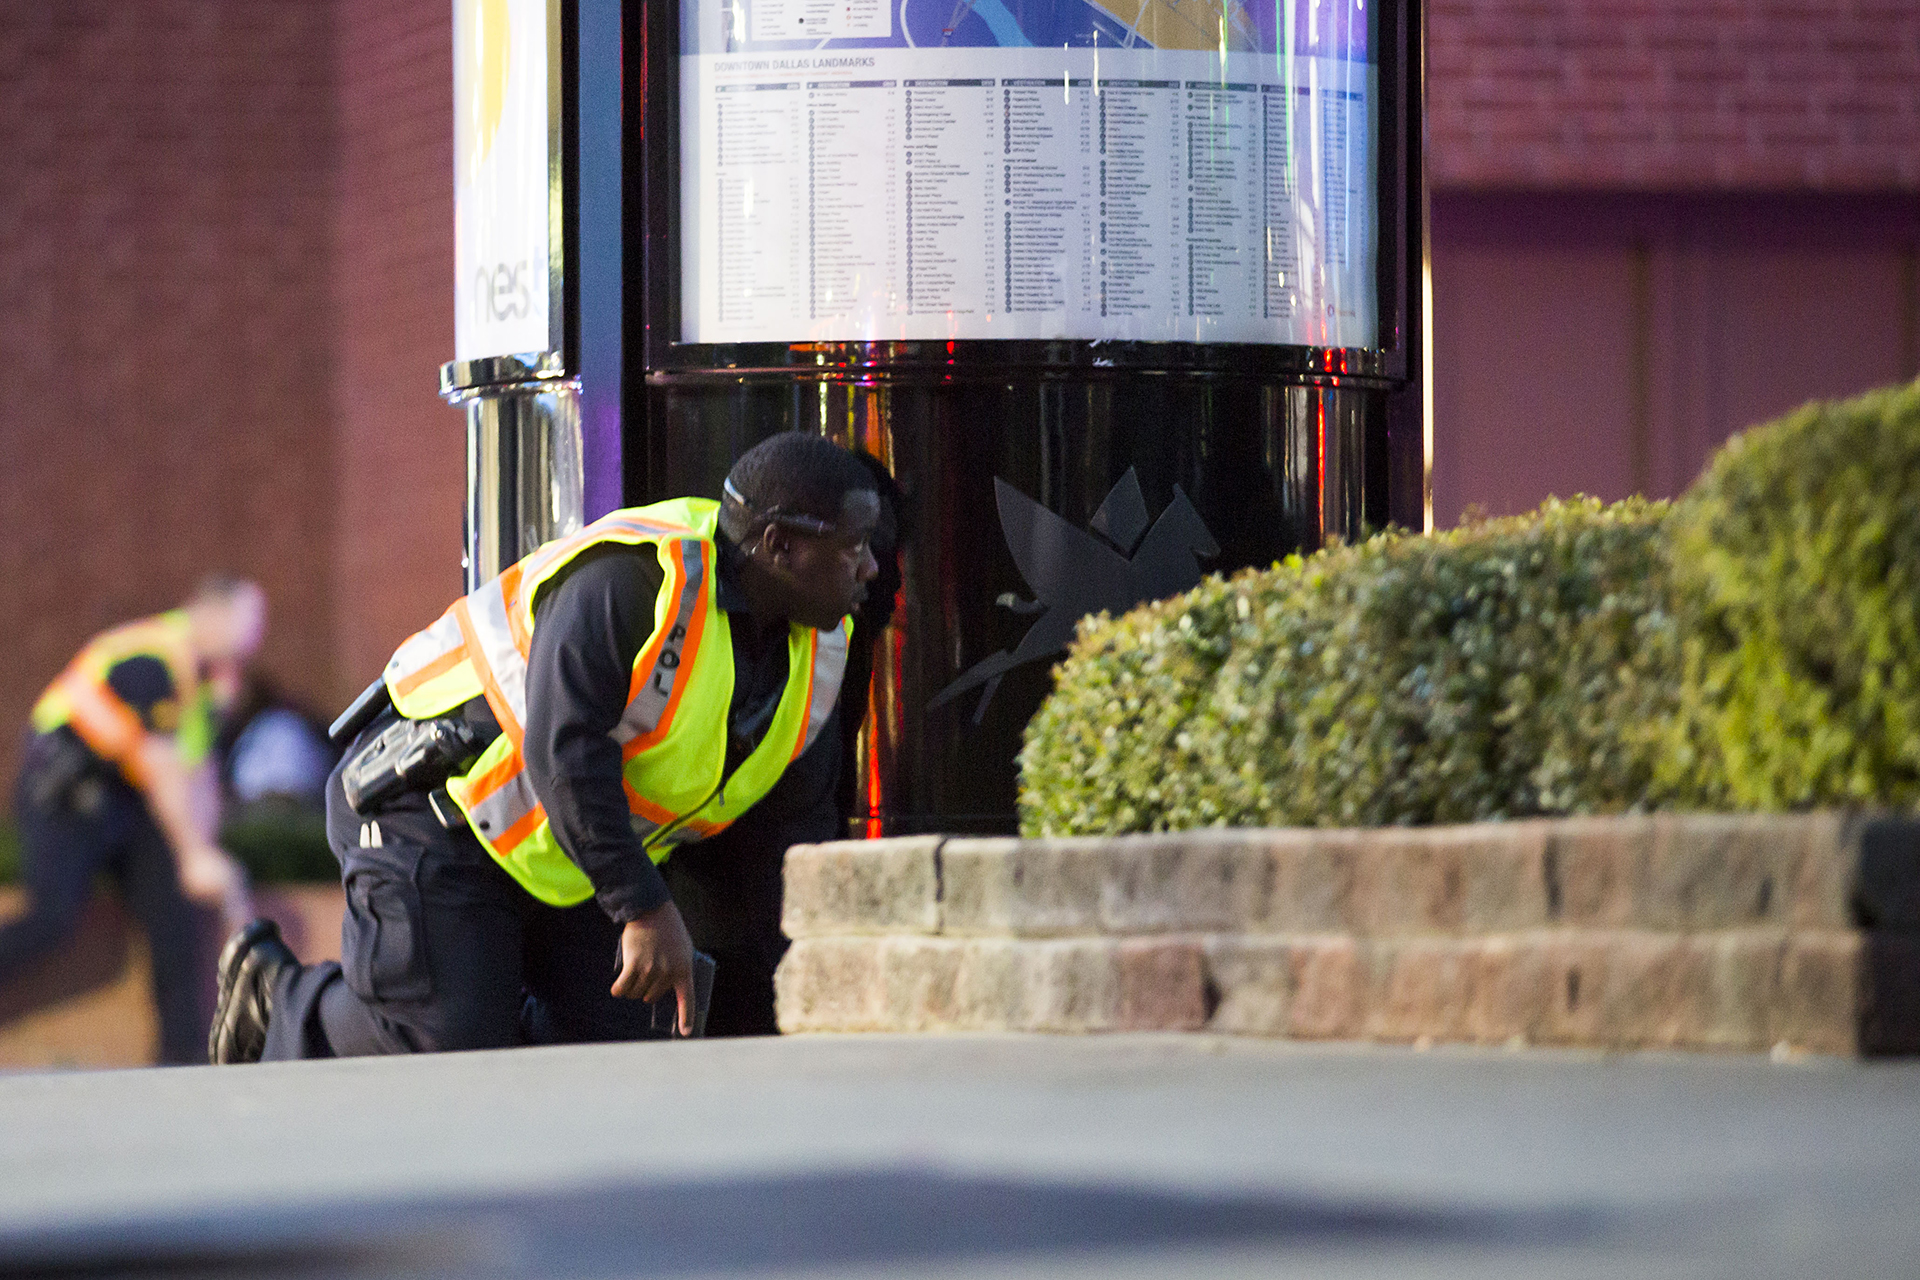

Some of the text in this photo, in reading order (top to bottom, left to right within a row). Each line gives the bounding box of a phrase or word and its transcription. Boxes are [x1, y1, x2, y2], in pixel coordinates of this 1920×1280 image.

[714, 57, 876, 72] DOWNTOWN DALLAS LANDMARKS
